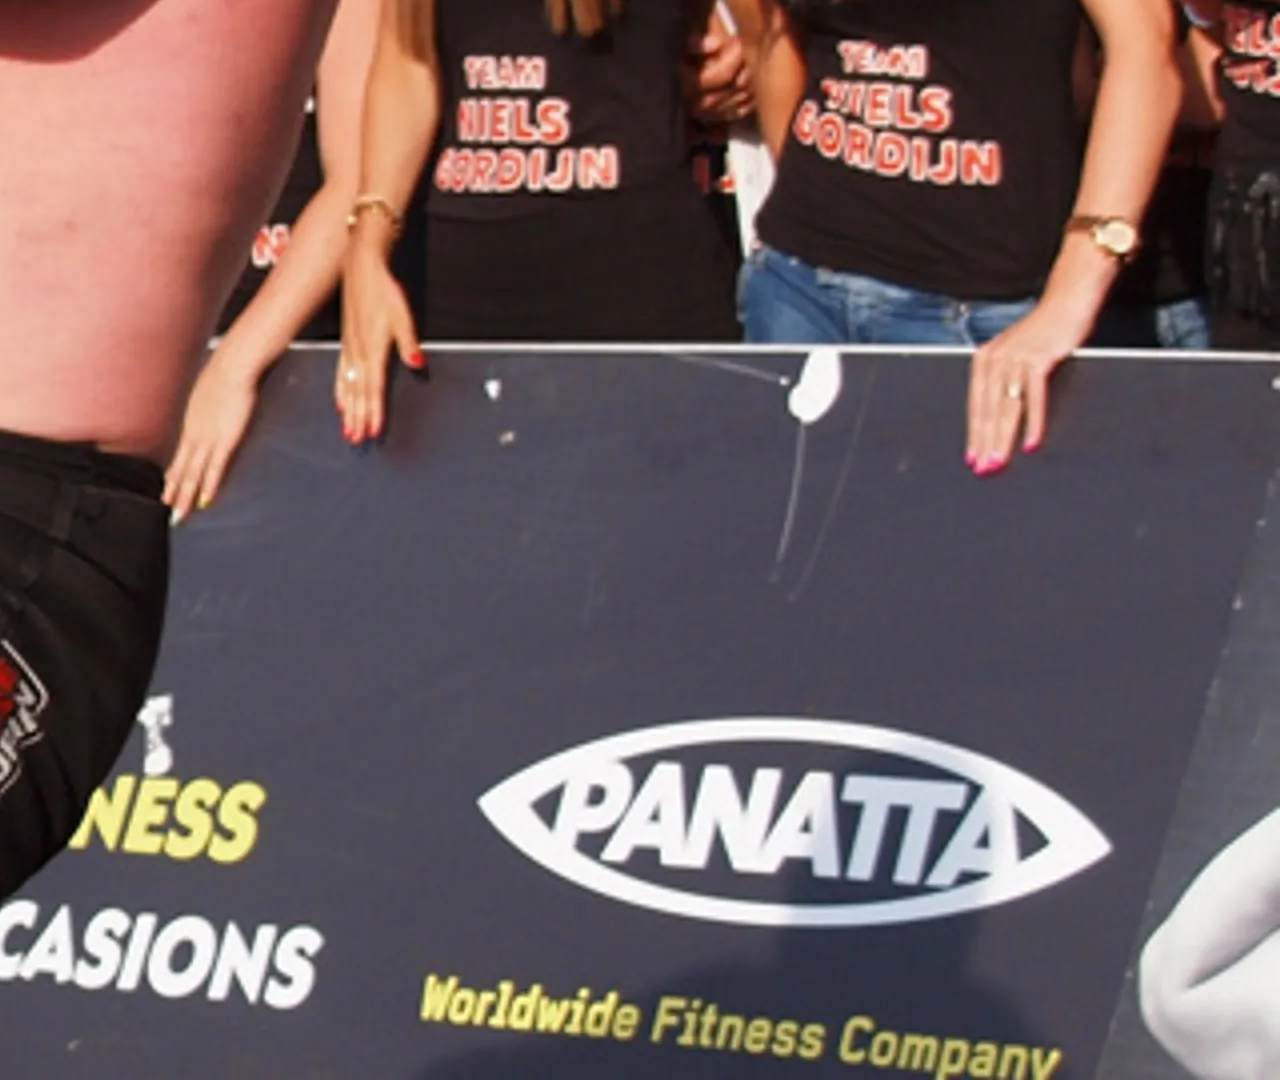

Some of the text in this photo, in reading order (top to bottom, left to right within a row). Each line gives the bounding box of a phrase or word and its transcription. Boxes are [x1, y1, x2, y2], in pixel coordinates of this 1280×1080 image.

[463, 55, 547, 90] TEAM
[793, 99, 1003, 186] GORDIJN
[552, 756, 1020, 890] PANATTA
[419, 972, 1064, 1080] Worldwide Fitness Company
